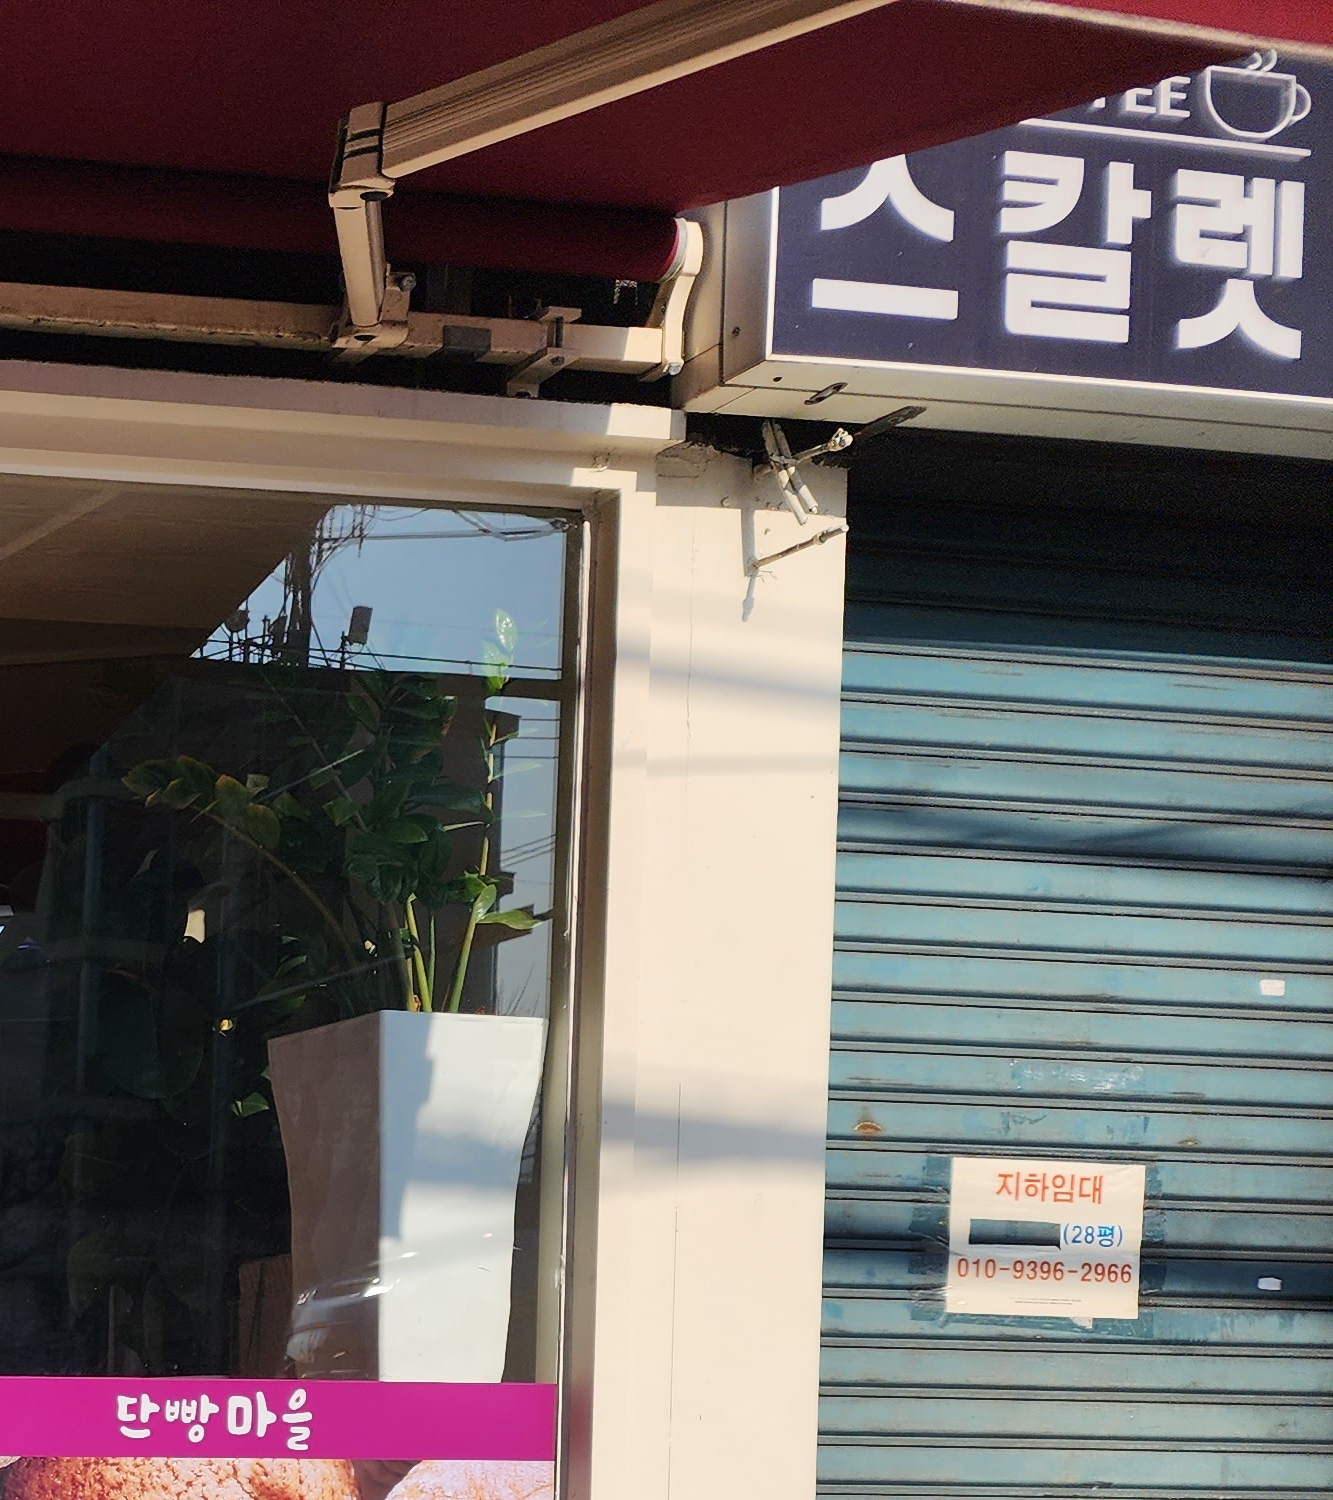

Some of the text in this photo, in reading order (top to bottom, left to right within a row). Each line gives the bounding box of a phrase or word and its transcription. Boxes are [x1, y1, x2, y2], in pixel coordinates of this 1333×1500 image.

[812, 150, 1305, 360] 스칼렛
[996, 1171, 1104, 1205] 지하임대
[1063, 1223, 1123, 1248] (28평)
[957, 1258, 1133, 1284] 010-9396-2966
[117, 1388, 313, 1451] 단빵마을
